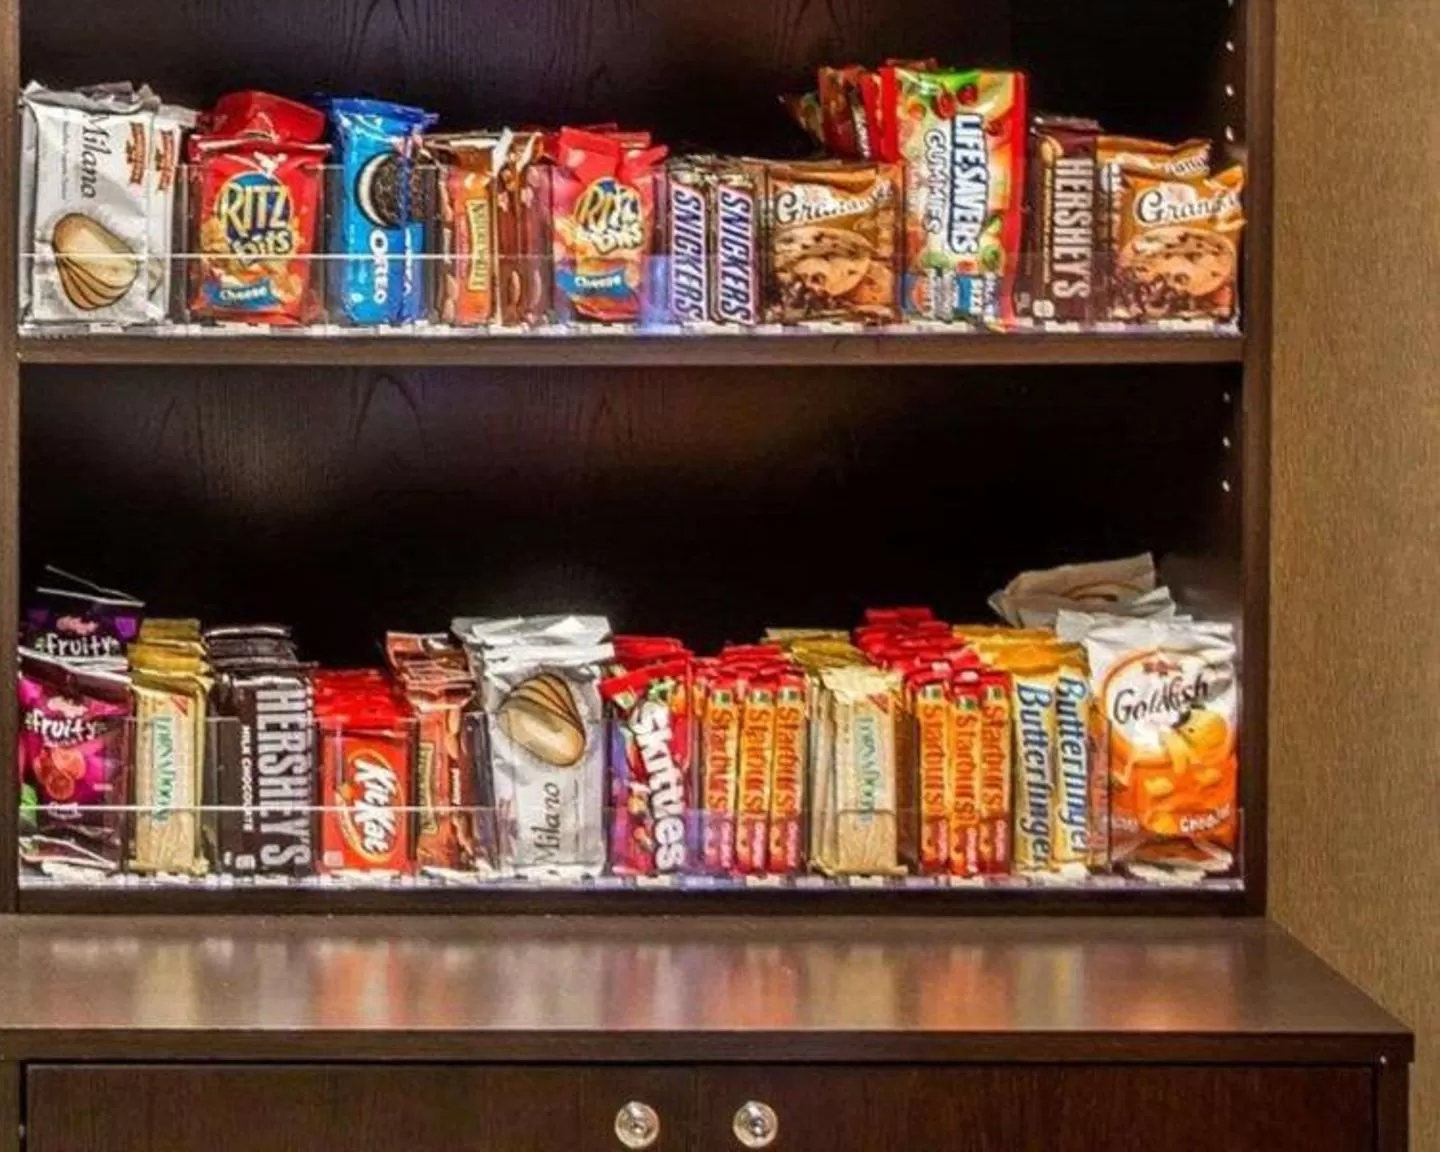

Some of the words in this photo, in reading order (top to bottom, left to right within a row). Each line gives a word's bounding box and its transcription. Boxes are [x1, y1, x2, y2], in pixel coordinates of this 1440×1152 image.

[79, 112, 113, 200] Milano
[217, 182, 291, 234] RITZ
[924, 129, 947, 234] GUMMIES
[672, 189, 708, 322] SNICKERS
[720, 191, 754, 325] SNICKERS
[1051, 158, 1095, 298] HERSHEY'S
[1112, 672, 1209, 726] Goldfish
[256, 689, 311, 867] HERSHEY'S
[530, 780, 561, 867] Milano
[629, 701, 686, 871] Skittles
[1016, 682, 1054, 868] Butterfinger
